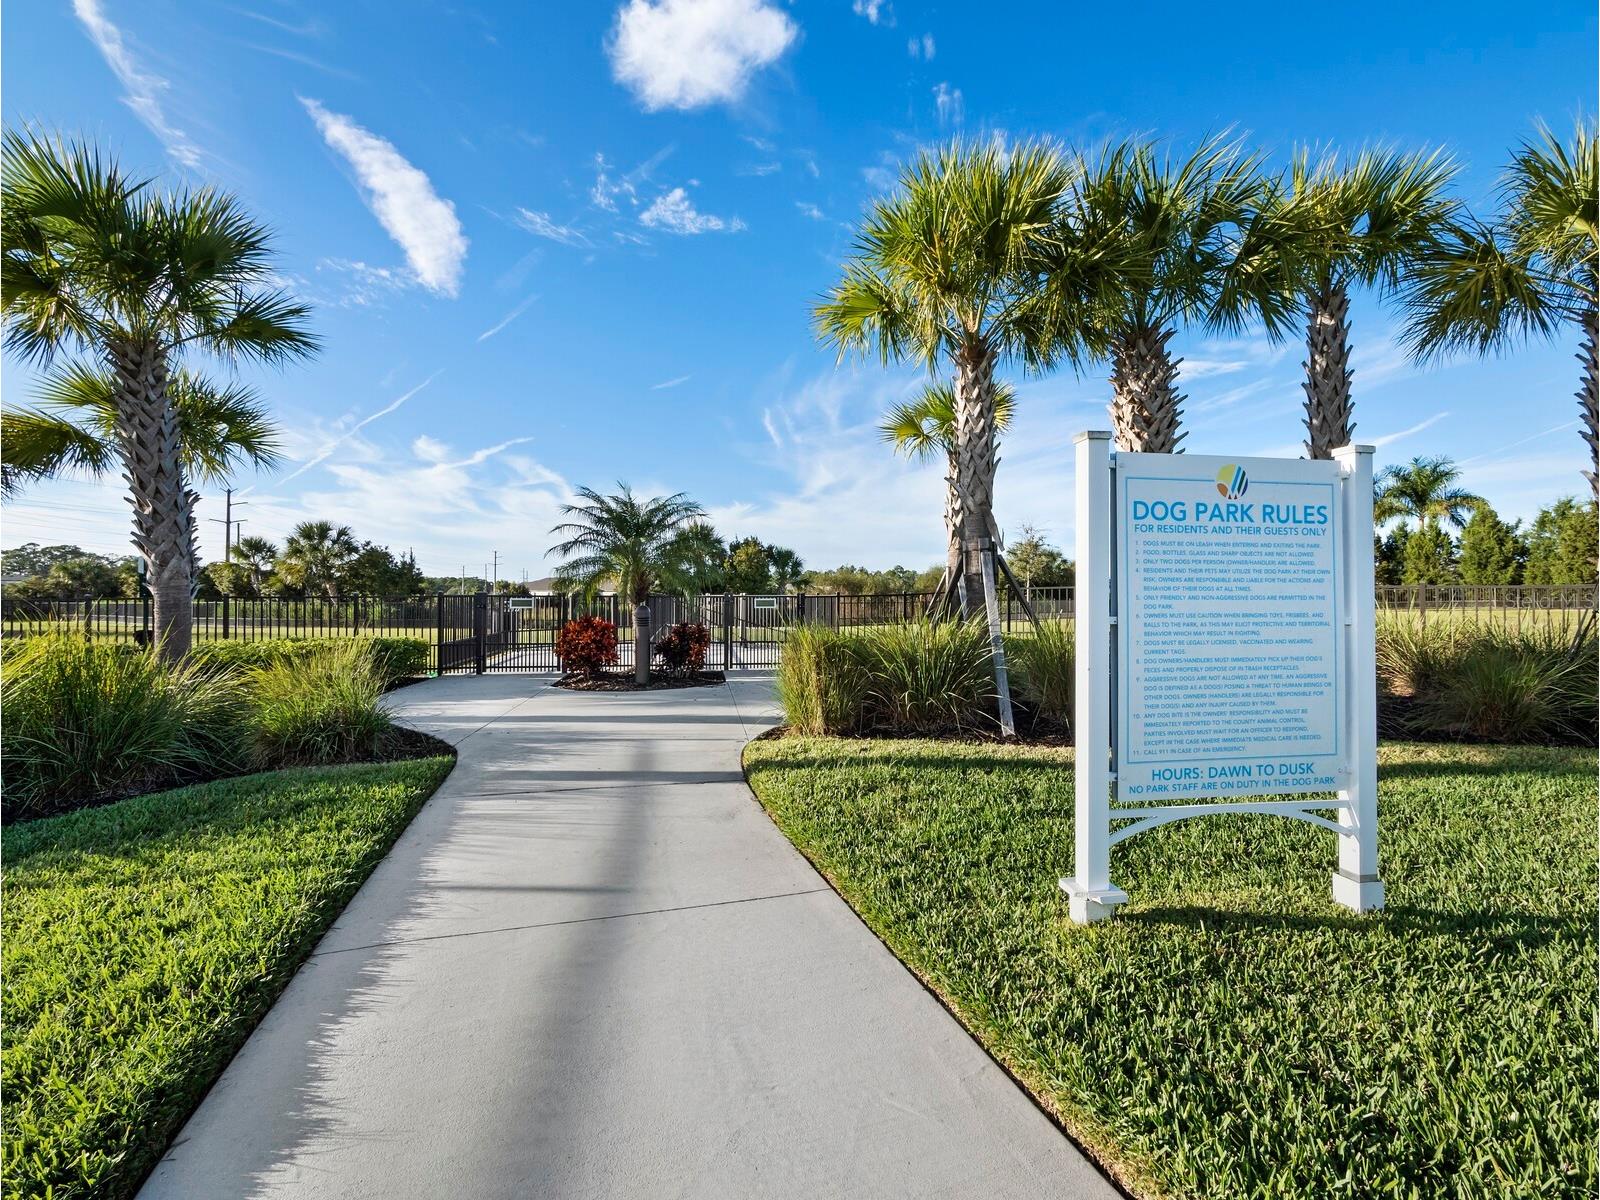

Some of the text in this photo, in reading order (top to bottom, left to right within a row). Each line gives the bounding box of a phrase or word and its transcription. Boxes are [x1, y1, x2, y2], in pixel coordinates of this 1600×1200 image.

[1133, 500, 1328, 524] DOG PARK RULES
[1134, 523, 1326, 536] FOR RESIDENTS AND THEIR GUESTS ONLY
[1151, 763, 1315, 781] HOURS: DAWN TO DUSK
[1128, 776, 1336, 794] NO PARK STAFF ARE ON DUTY IN THE DOG PARK
